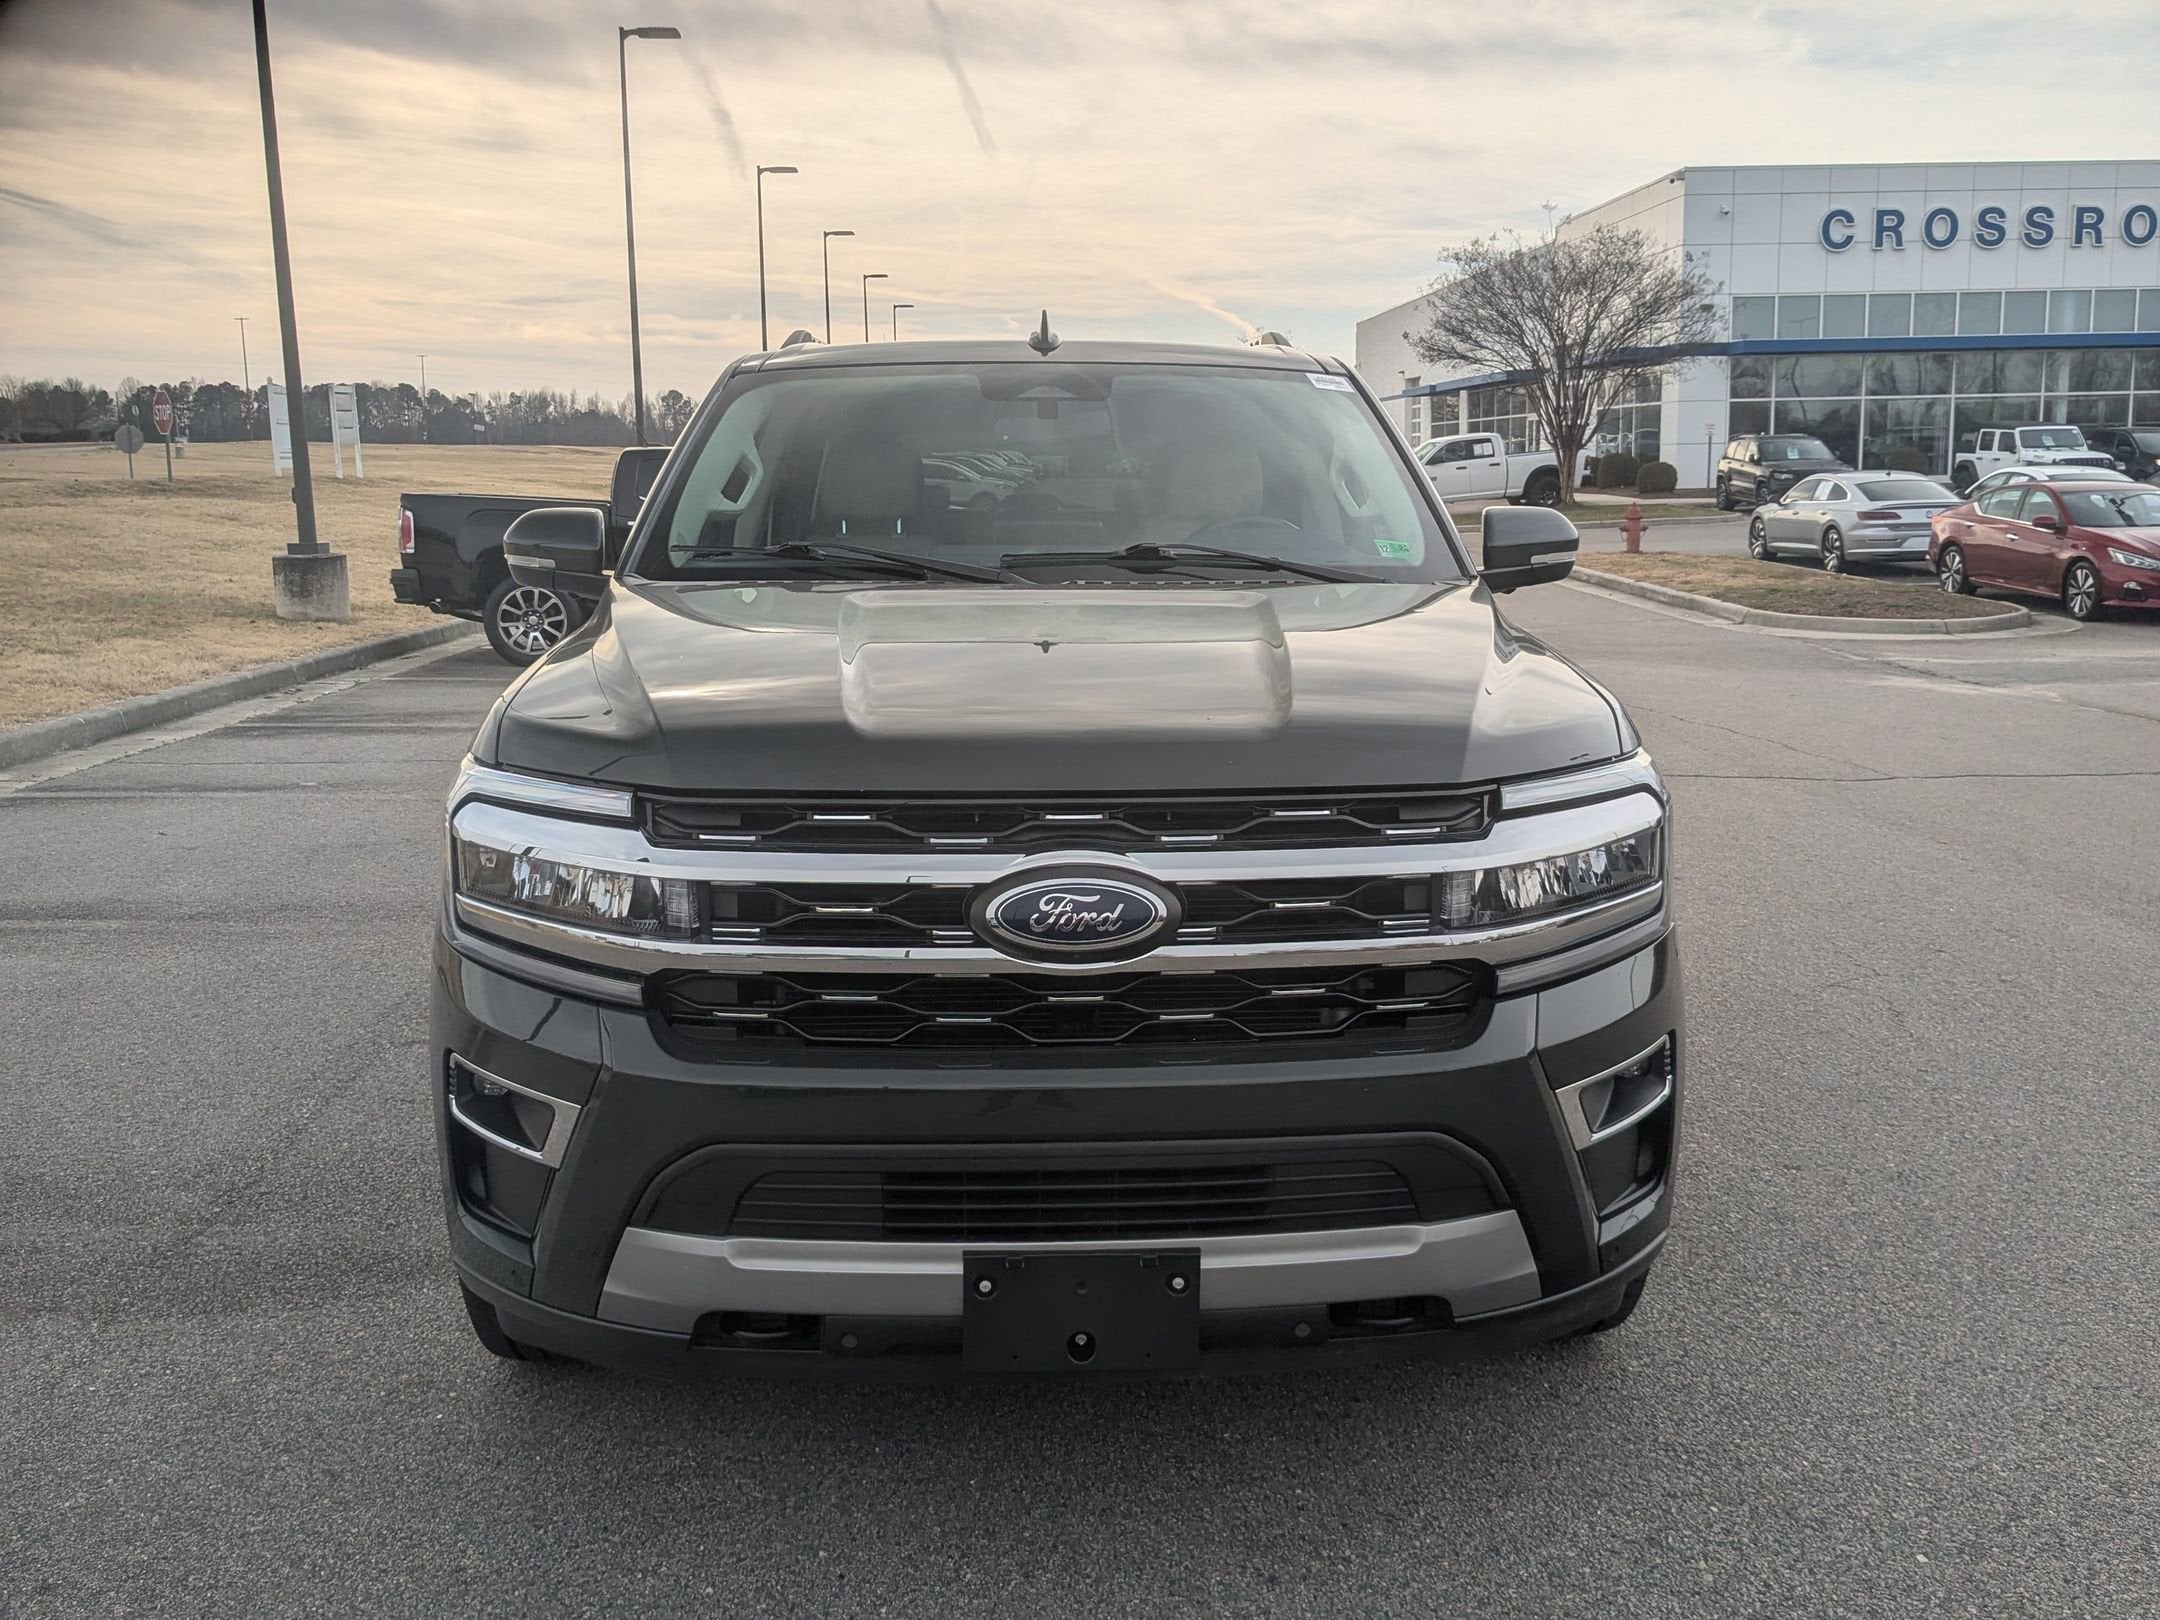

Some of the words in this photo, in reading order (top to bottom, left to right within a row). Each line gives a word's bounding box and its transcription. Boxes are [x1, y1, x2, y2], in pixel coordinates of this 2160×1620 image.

[1820, 203, 2159, 252] CROSSRO
[155, 404, 171, 421] STOP
[1029, 893, 1124, 933] Ford
